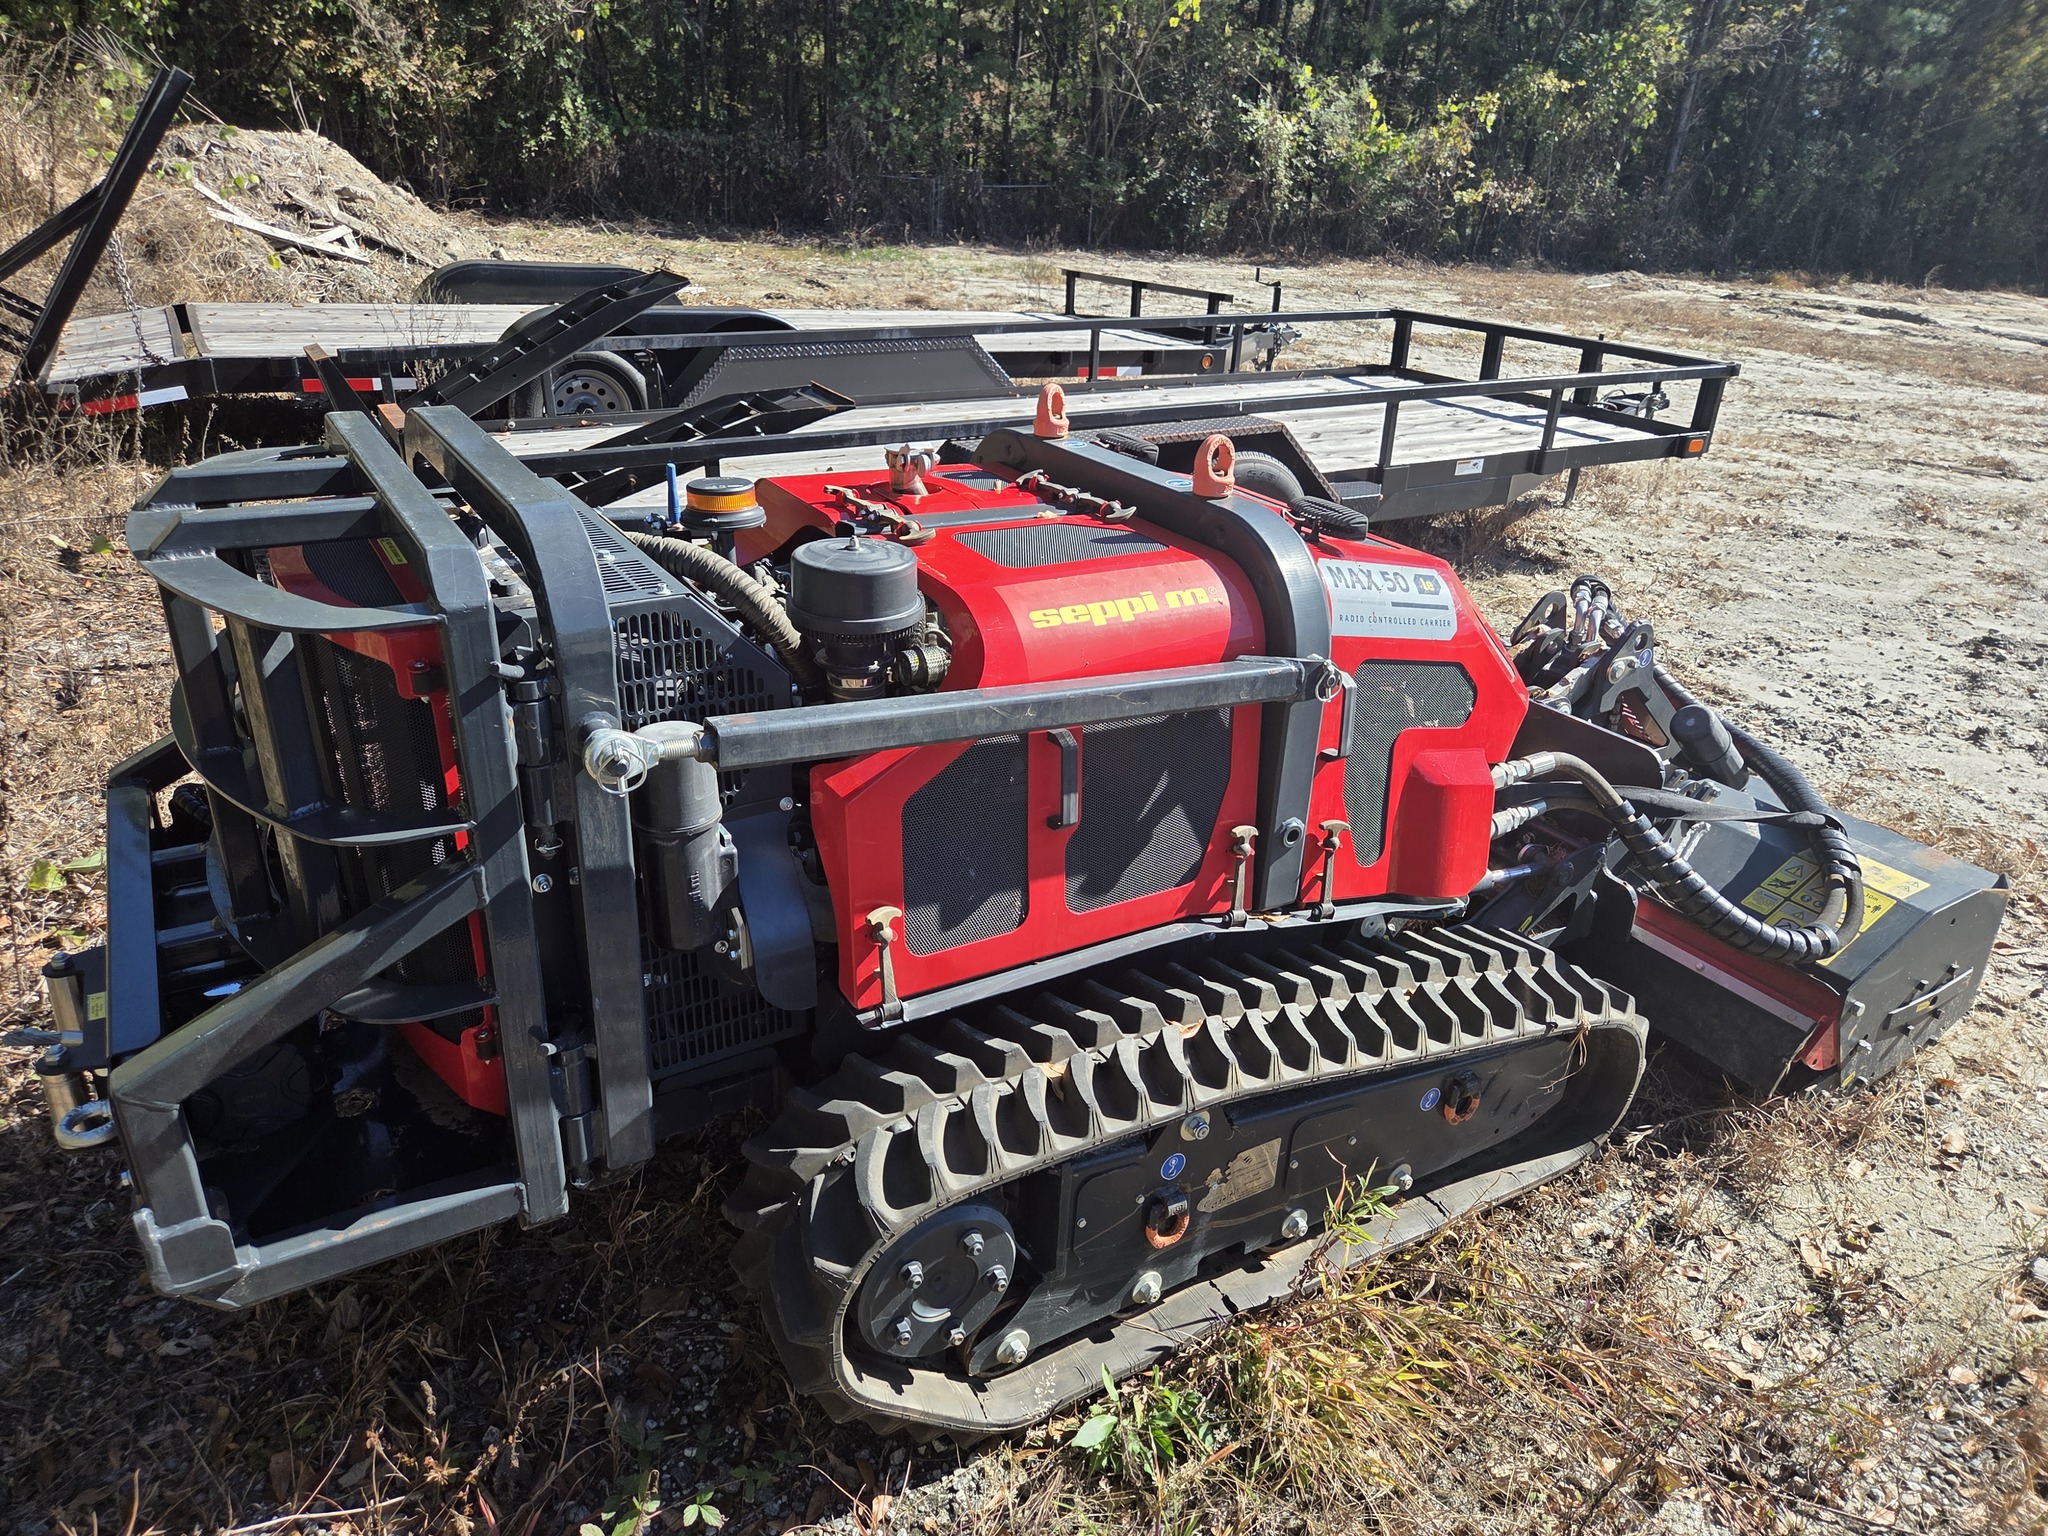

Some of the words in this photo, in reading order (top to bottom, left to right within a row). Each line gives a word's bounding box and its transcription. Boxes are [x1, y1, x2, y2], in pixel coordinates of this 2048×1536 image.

[1326, 565, 1380, 592] MAX
[1379, 570, 1411, 594] 50
[1028, 590, 1160, 629] seppi
[1339, 614, 1365, 623] RADIO
[1368, 615, 1417, 626] CONTROLLED
[1420, 618, 1452, 628] CARRIER
